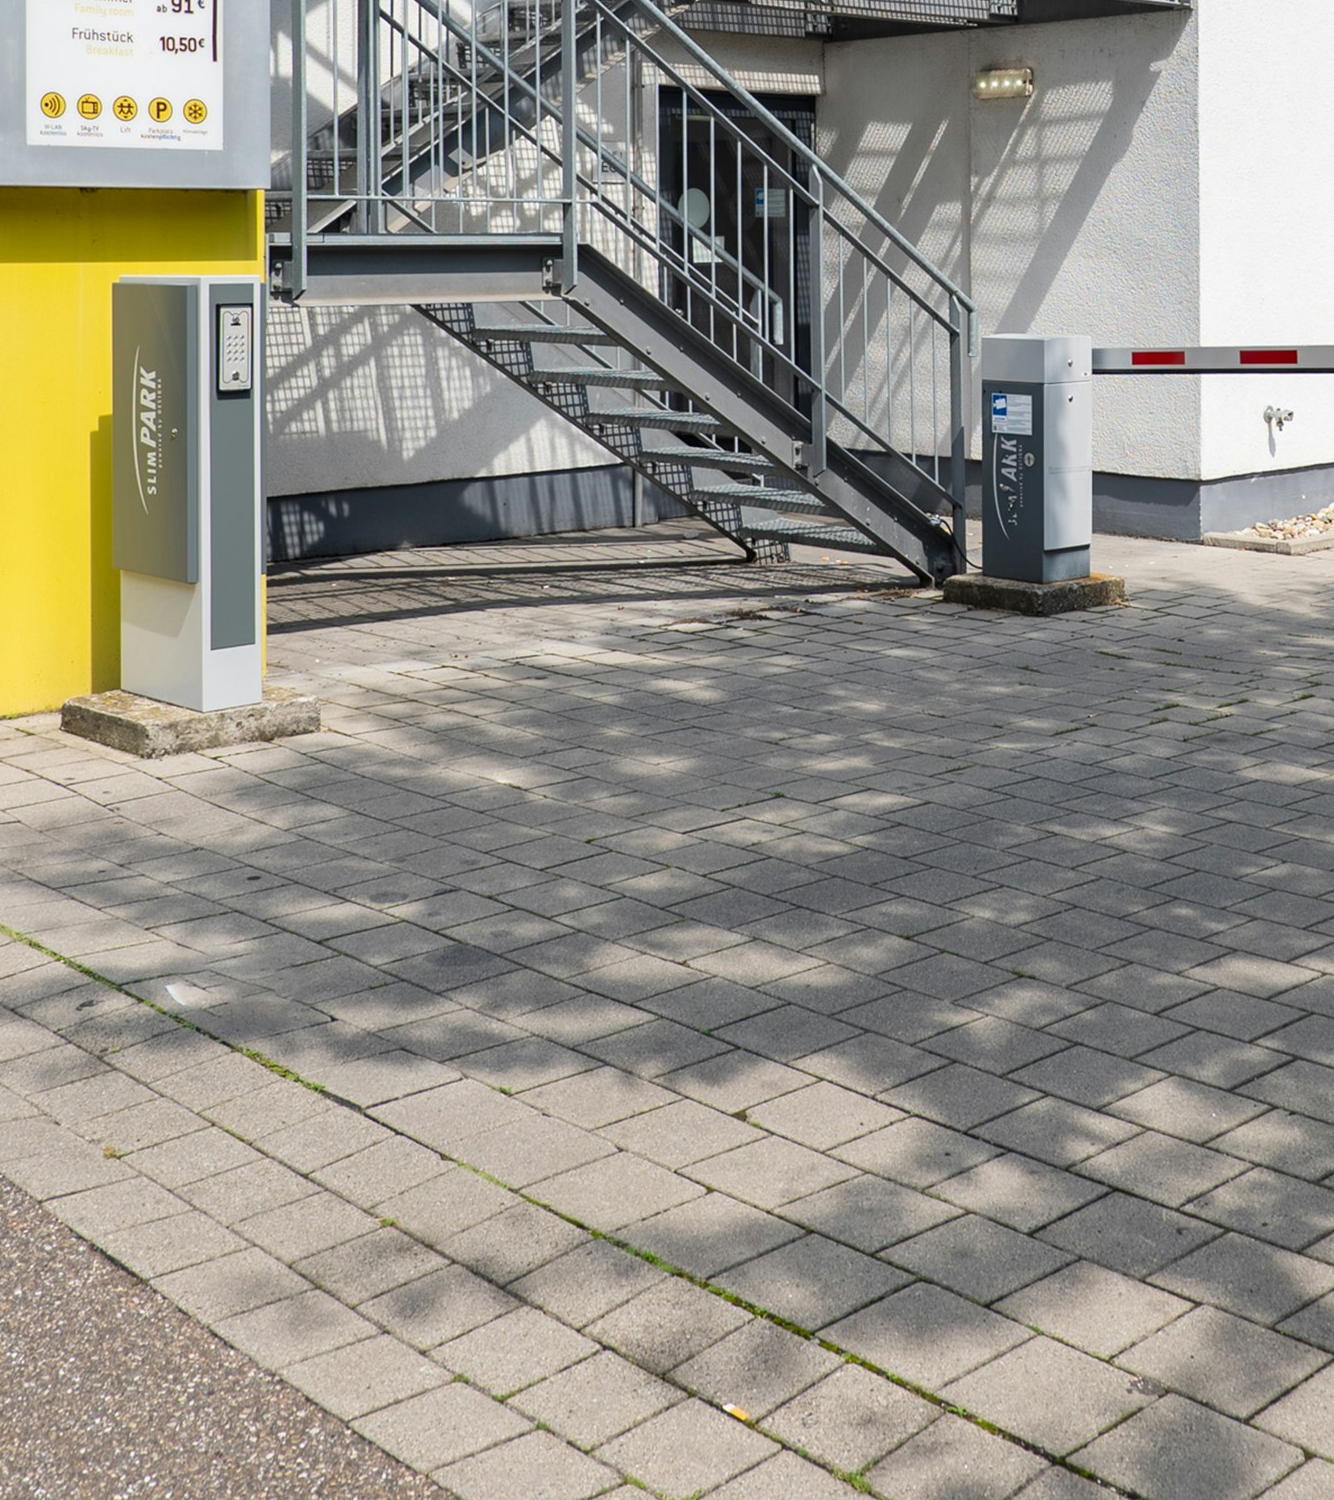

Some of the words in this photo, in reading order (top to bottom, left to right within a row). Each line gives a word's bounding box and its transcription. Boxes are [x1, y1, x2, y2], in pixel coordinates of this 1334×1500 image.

[74, 3, 107, 17] Family
[156, 4, 168, 13] ab
[71, 27, 134, 43] Frühstück
